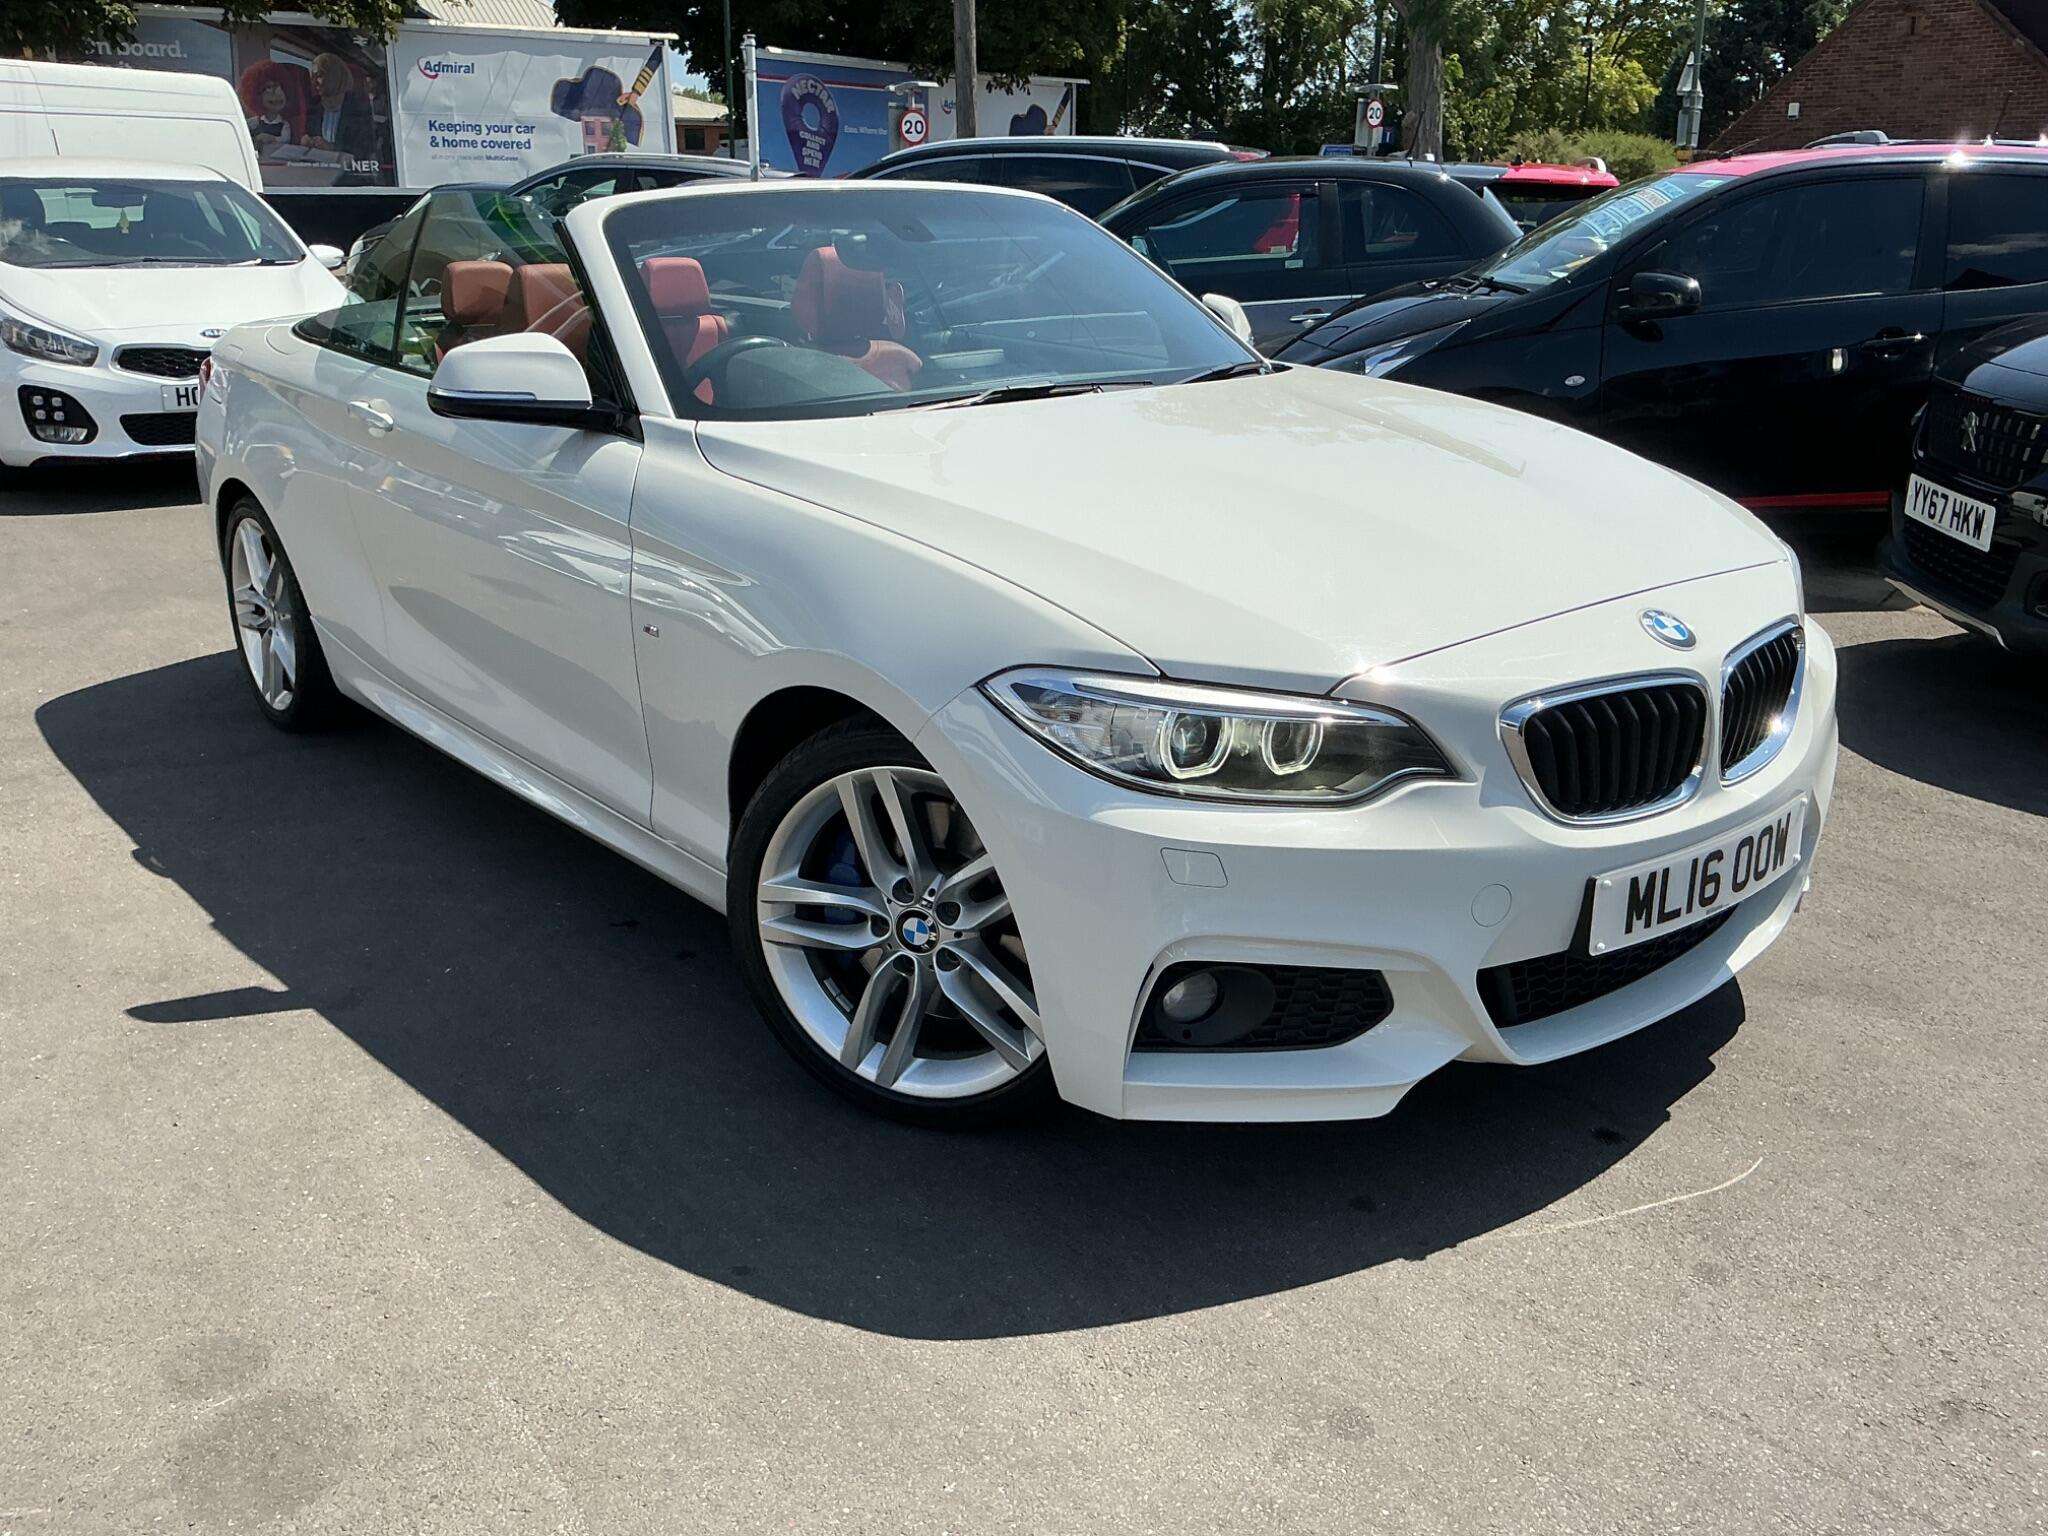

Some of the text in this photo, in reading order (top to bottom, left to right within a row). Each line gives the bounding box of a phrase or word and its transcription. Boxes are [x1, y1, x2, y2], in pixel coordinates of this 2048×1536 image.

[423, 60, 475, 74] Admiral
[1369, 107, 1381, 119] 20
[428, 119, 536, 135] Keeping your car
[903, 120, 925, 135] 20
[430, 136, 532, 150] & home covered
[342, 159, 380, 173] LNER
[1913, 481, 1986, 541] YY67 HKW
[1624, 811, 1792, 935] ML16 OOW
